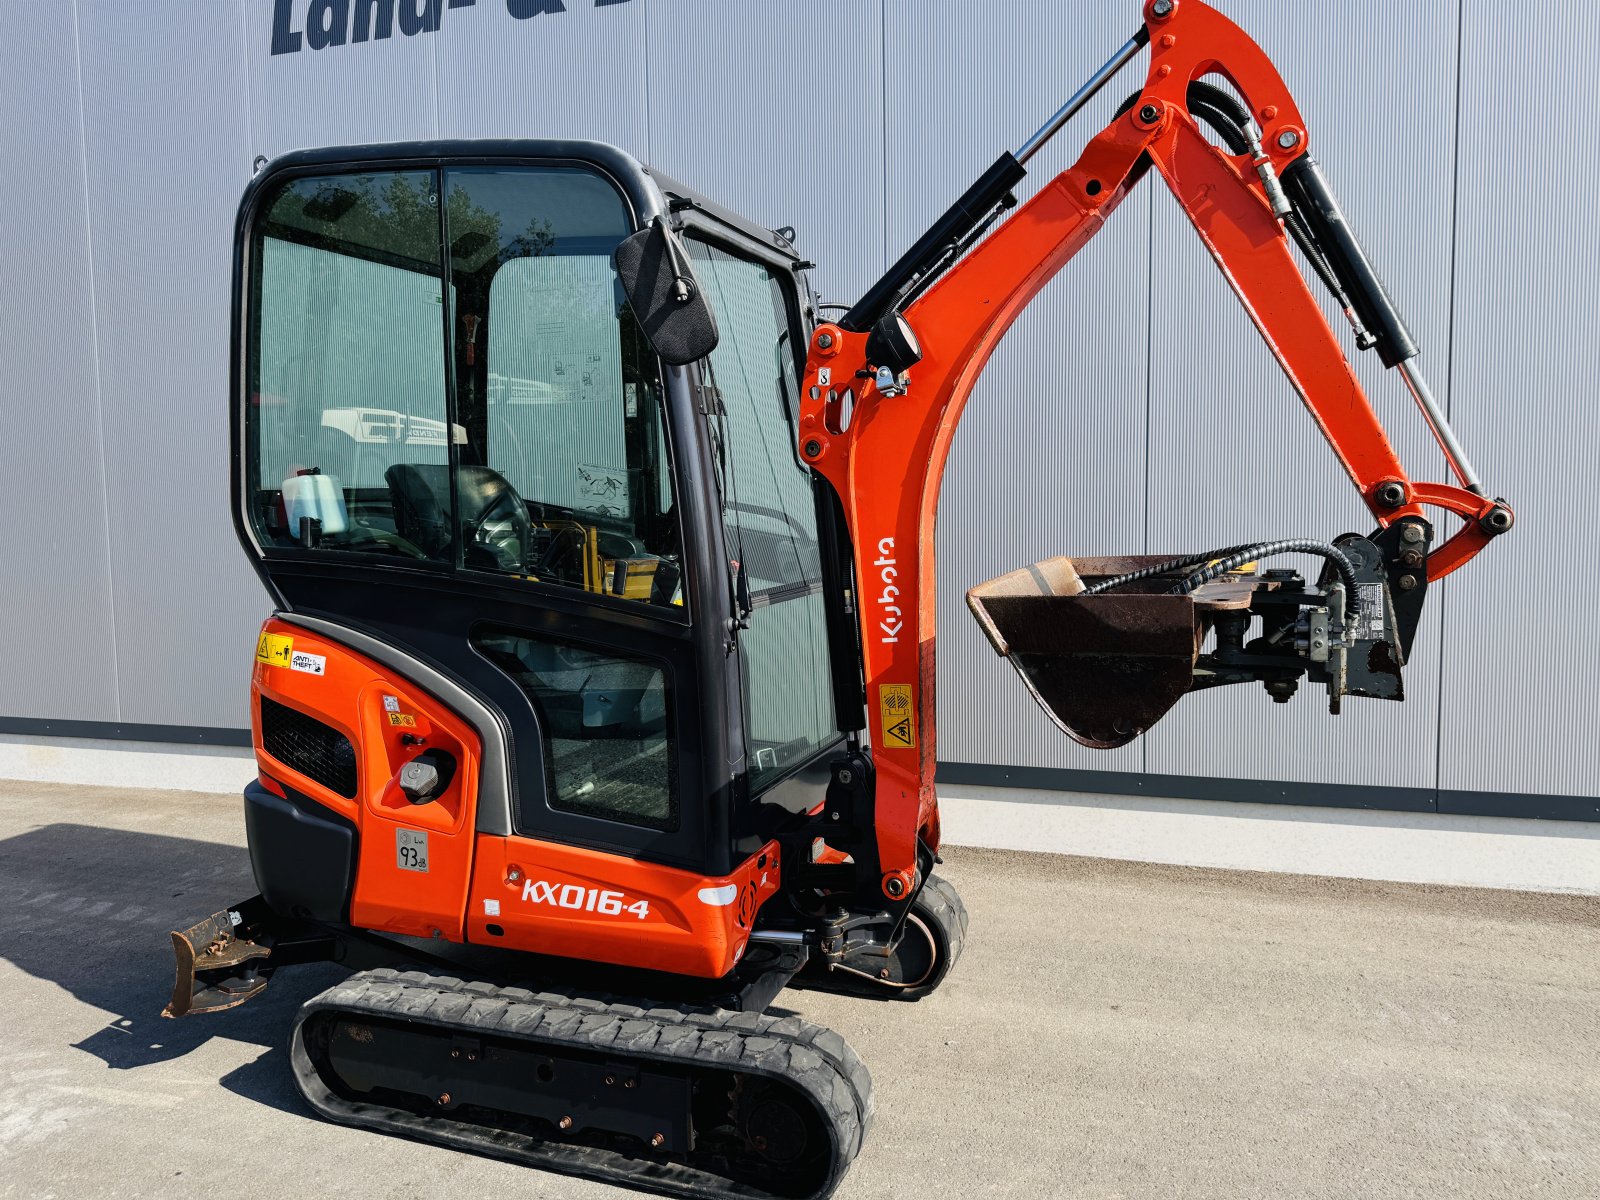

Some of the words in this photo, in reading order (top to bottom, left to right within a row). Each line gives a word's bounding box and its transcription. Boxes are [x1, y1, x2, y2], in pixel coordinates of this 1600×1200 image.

[873, 537, 902, 643] Kubota
[293, 661, 312, 669] THEFT
[400, 846, 418, 867] 93
[521, 878, 649, 920] KX016-4
